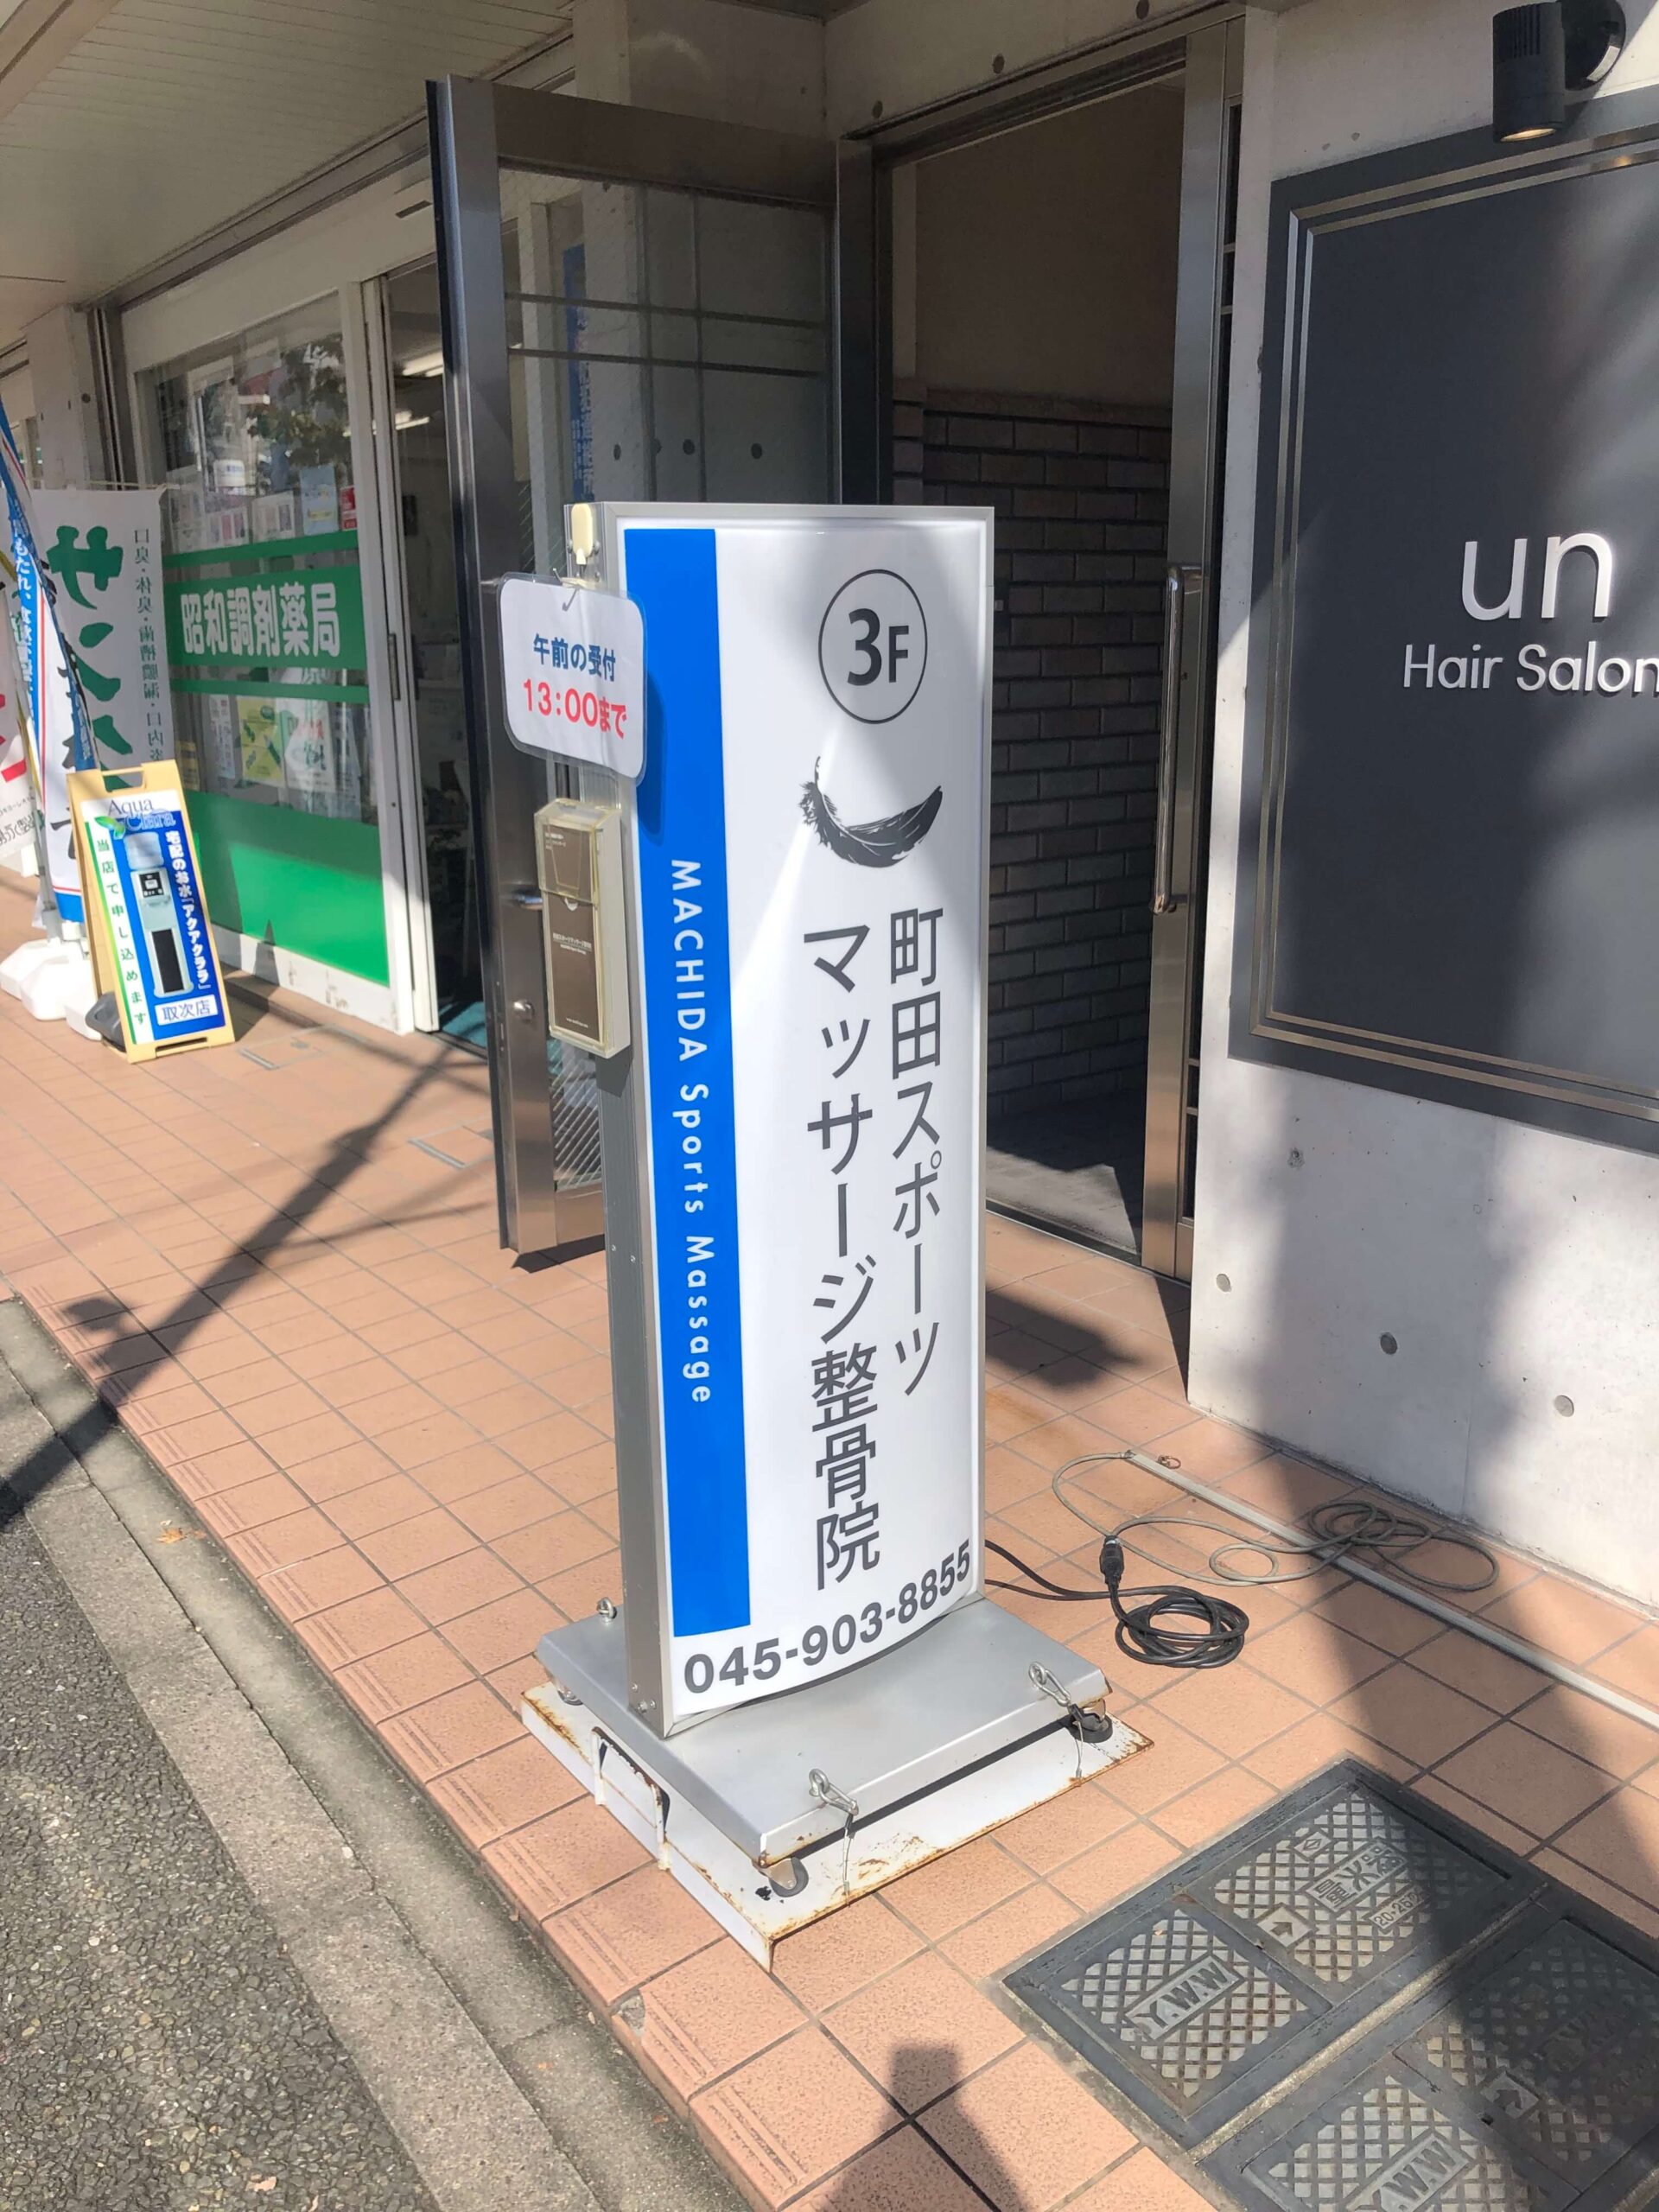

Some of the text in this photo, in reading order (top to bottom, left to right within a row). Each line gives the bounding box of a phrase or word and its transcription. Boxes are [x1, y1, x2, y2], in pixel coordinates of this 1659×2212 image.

[1462, 532, 1612, 620] un
[180, 582, 341, 658] 昭和調剤薬局
[533, 632, 616, 683] 午前の受付
[847, 607, 910, 687] 3F
[1403, 640, 1659, 693] Hair Salon
[523, 677, 627, 740] 13:00まで
[107, 798, 154, 817] Aqua
[96, 839, 146, 1025] 当店で申し込めます
[164, 830, 212, 990] 宅配のお水「アクアクララ」
[162, 999, 211, 1022] 取次店
[671, 859, 715, 1403] MACHIDA Sports Massage
[890, 907, 944, 1397] 町田スポーツ
[804, 924, 880, 1591] マッサージ整骨院
[683, 1538, 971, 1694] 045-903-8855
[1133, 1961, 1229, 2028] Y.W.W
